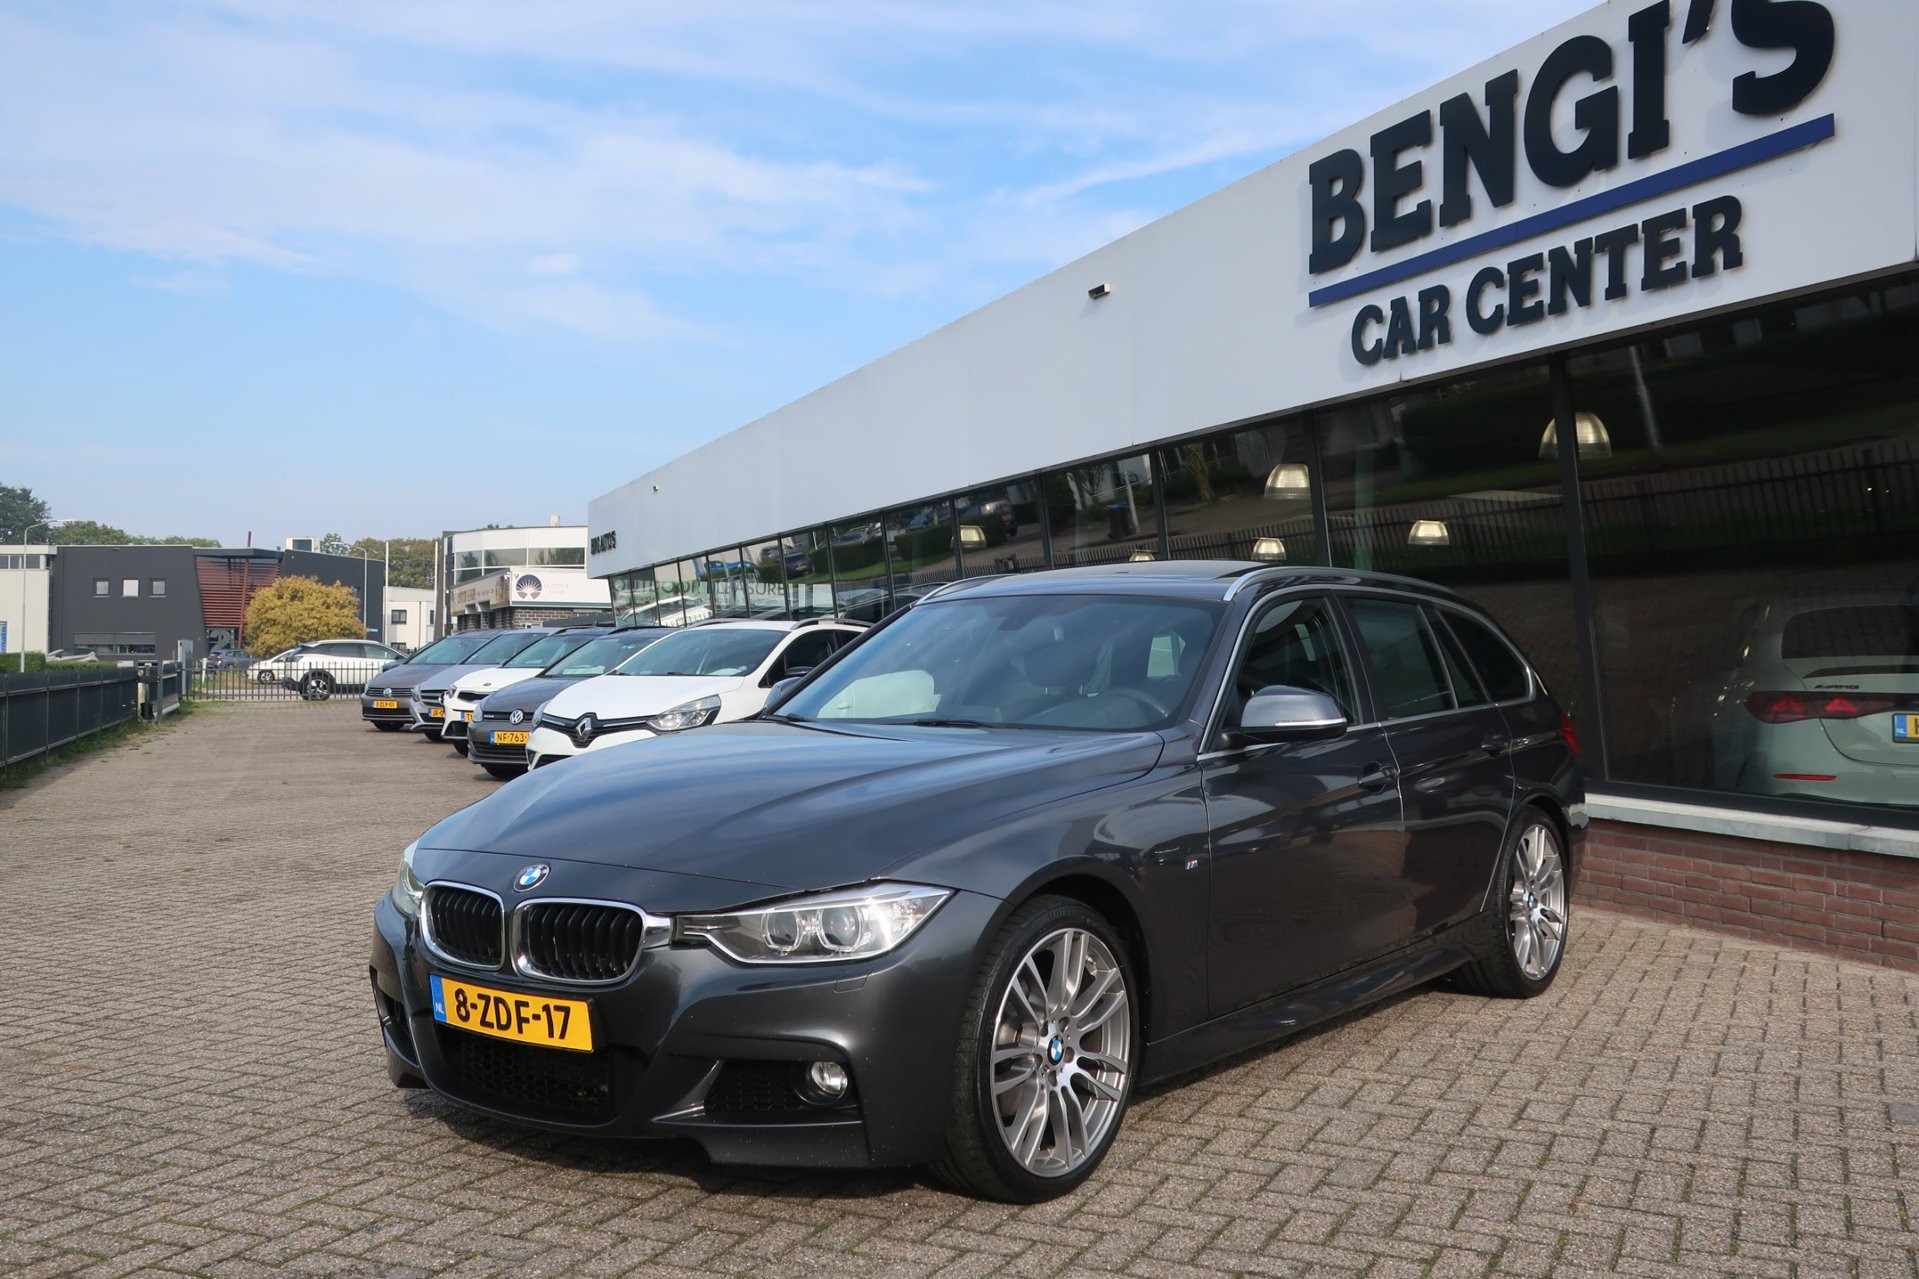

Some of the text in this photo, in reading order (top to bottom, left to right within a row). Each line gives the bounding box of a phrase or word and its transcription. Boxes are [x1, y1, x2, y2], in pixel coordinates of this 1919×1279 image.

[1309, 0, 1836, 275] BENGI'S
[1351, 194, 1744, 366] CAR CENTER
[497, 732, 527, 743] NF-763-
[435, 1002, 445, 1014] NL
[454, 988, 573, 1040] 8-ZDF-17
